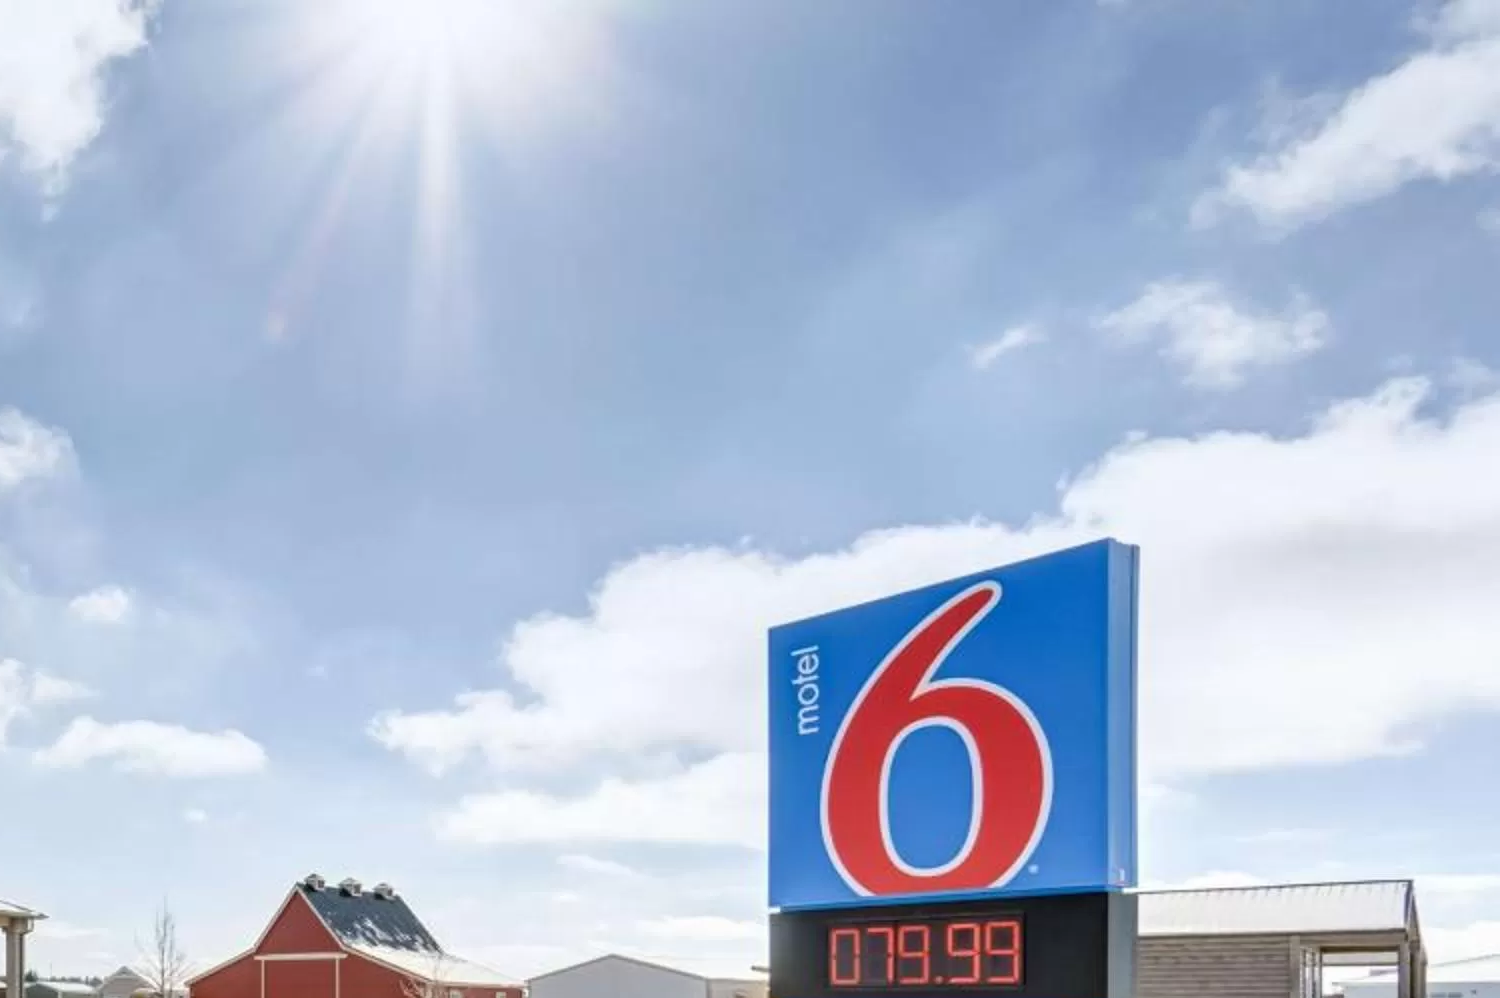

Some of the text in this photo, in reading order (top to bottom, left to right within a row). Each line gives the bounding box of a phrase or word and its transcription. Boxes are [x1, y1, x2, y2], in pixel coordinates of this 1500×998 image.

[791, 645, 819, 735] motel
[820, 580, 1054, 897] 6
[829, 920, 1021, 986] 079.99
